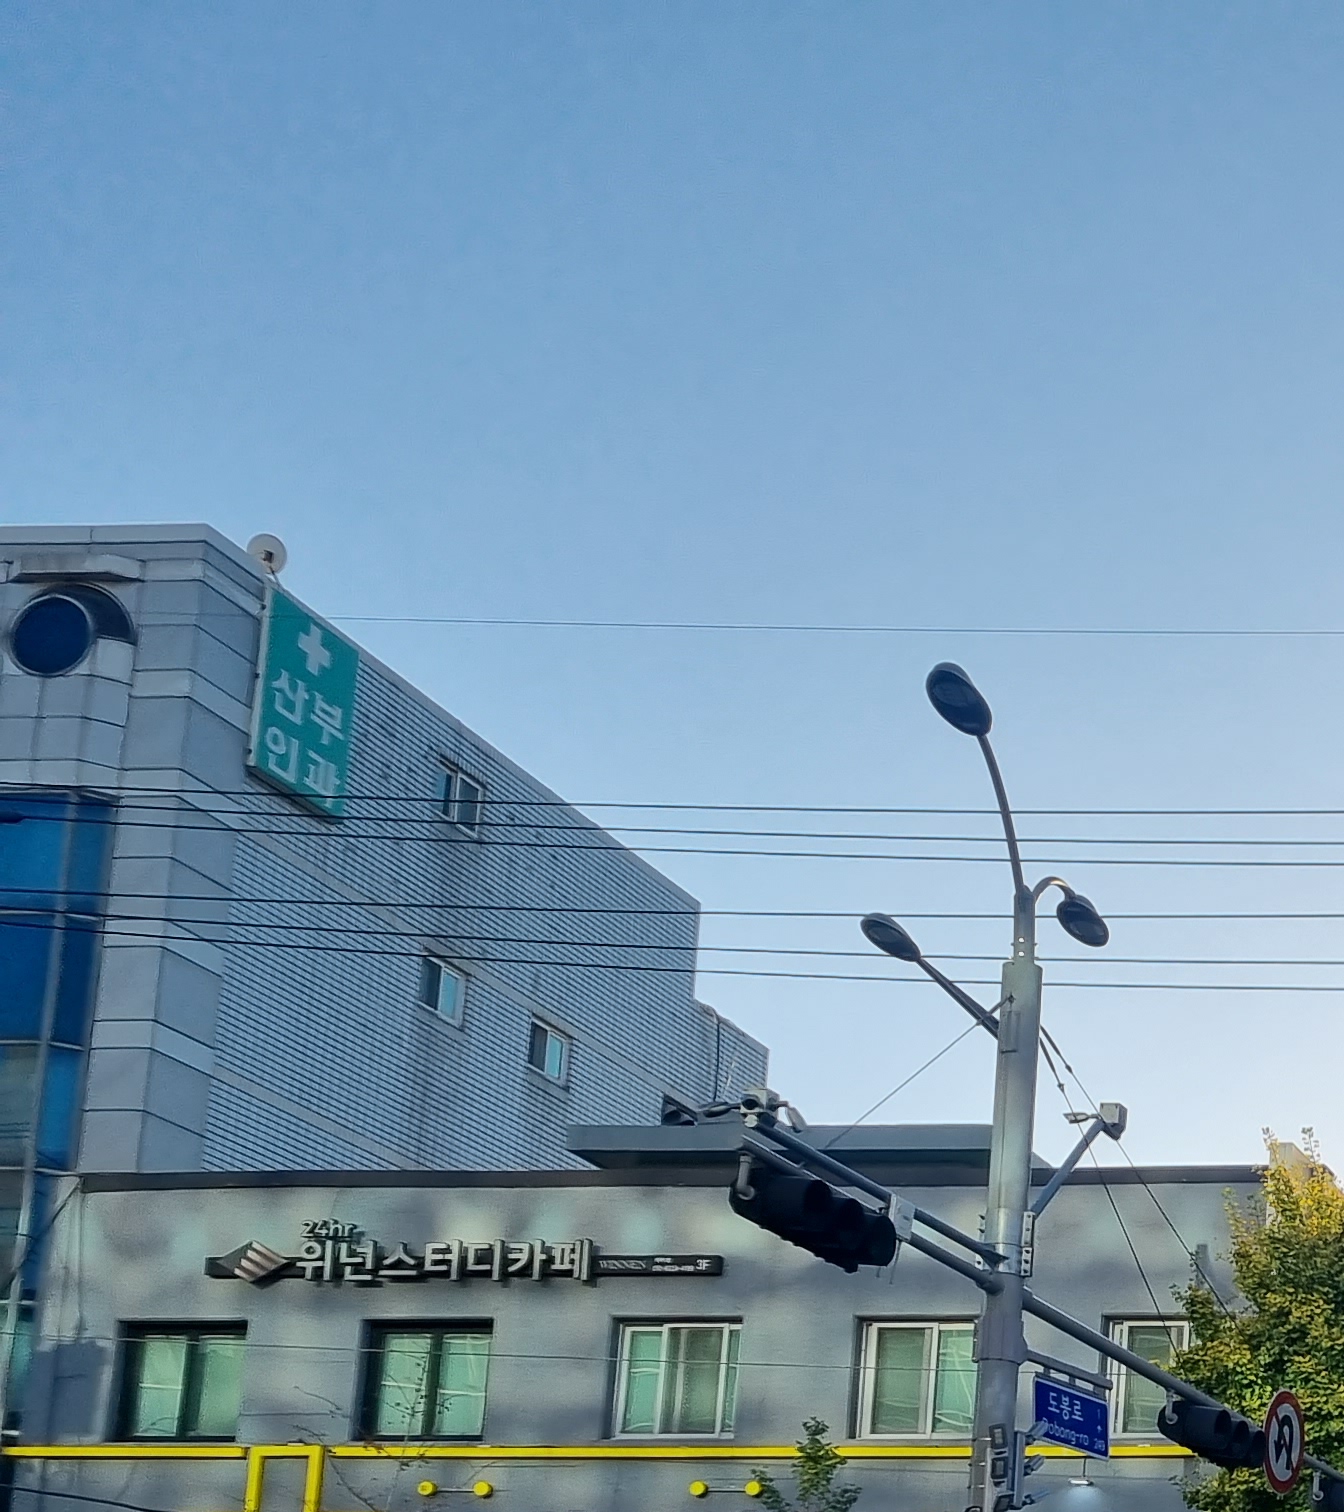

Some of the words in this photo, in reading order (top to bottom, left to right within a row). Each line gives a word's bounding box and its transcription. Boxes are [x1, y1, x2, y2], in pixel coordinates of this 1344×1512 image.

[302, 1220, 352, 1237] 24hr
[297, 1238, 593, 1282] 위넌스터디카페
[1047, 1391, 1084, 1421] 도봉로
[1042, 1416, 1090, 1446] obong-ro
